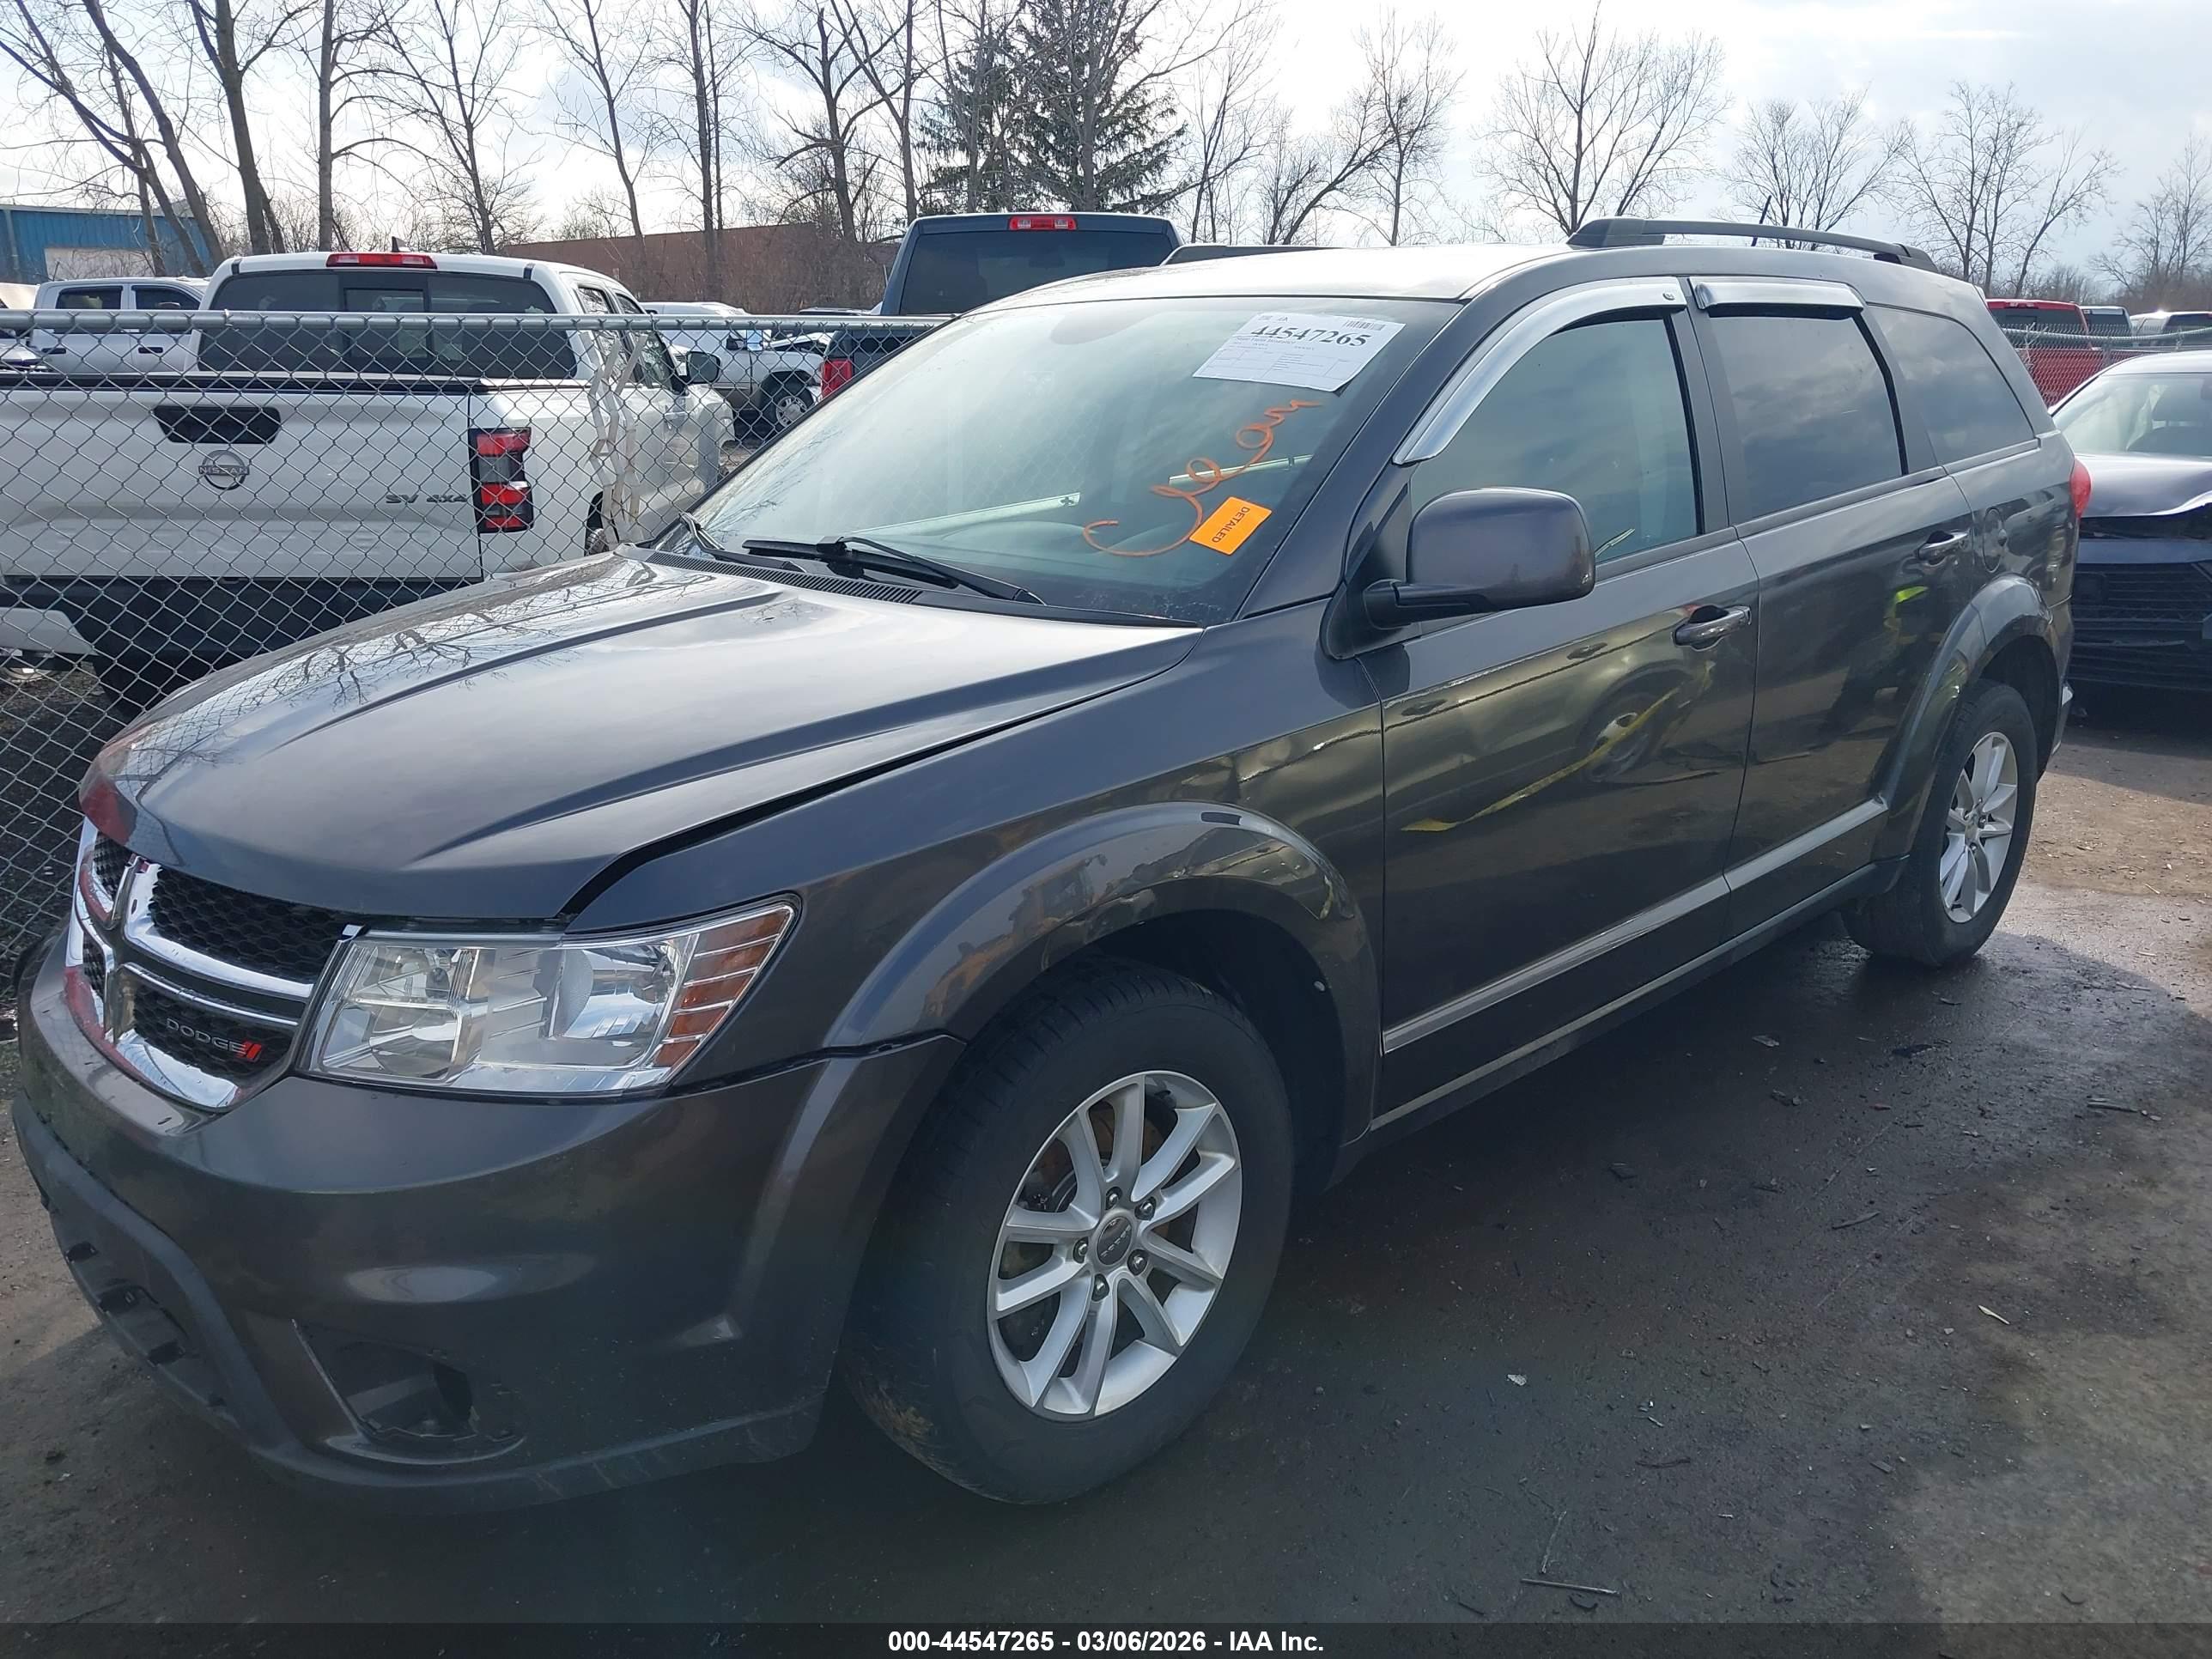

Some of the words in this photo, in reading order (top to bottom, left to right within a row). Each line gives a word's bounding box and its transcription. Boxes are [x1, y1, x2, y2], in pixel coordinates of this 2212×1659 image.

[1251, 325, 1372, 347] 44547265
[198, 466, 249, 475] NISSAN
[386, 494, 419, 503] SV
[1212, 506, 1250, 543] DETAILED
[166, 1018, 247, 1055] DODGE
